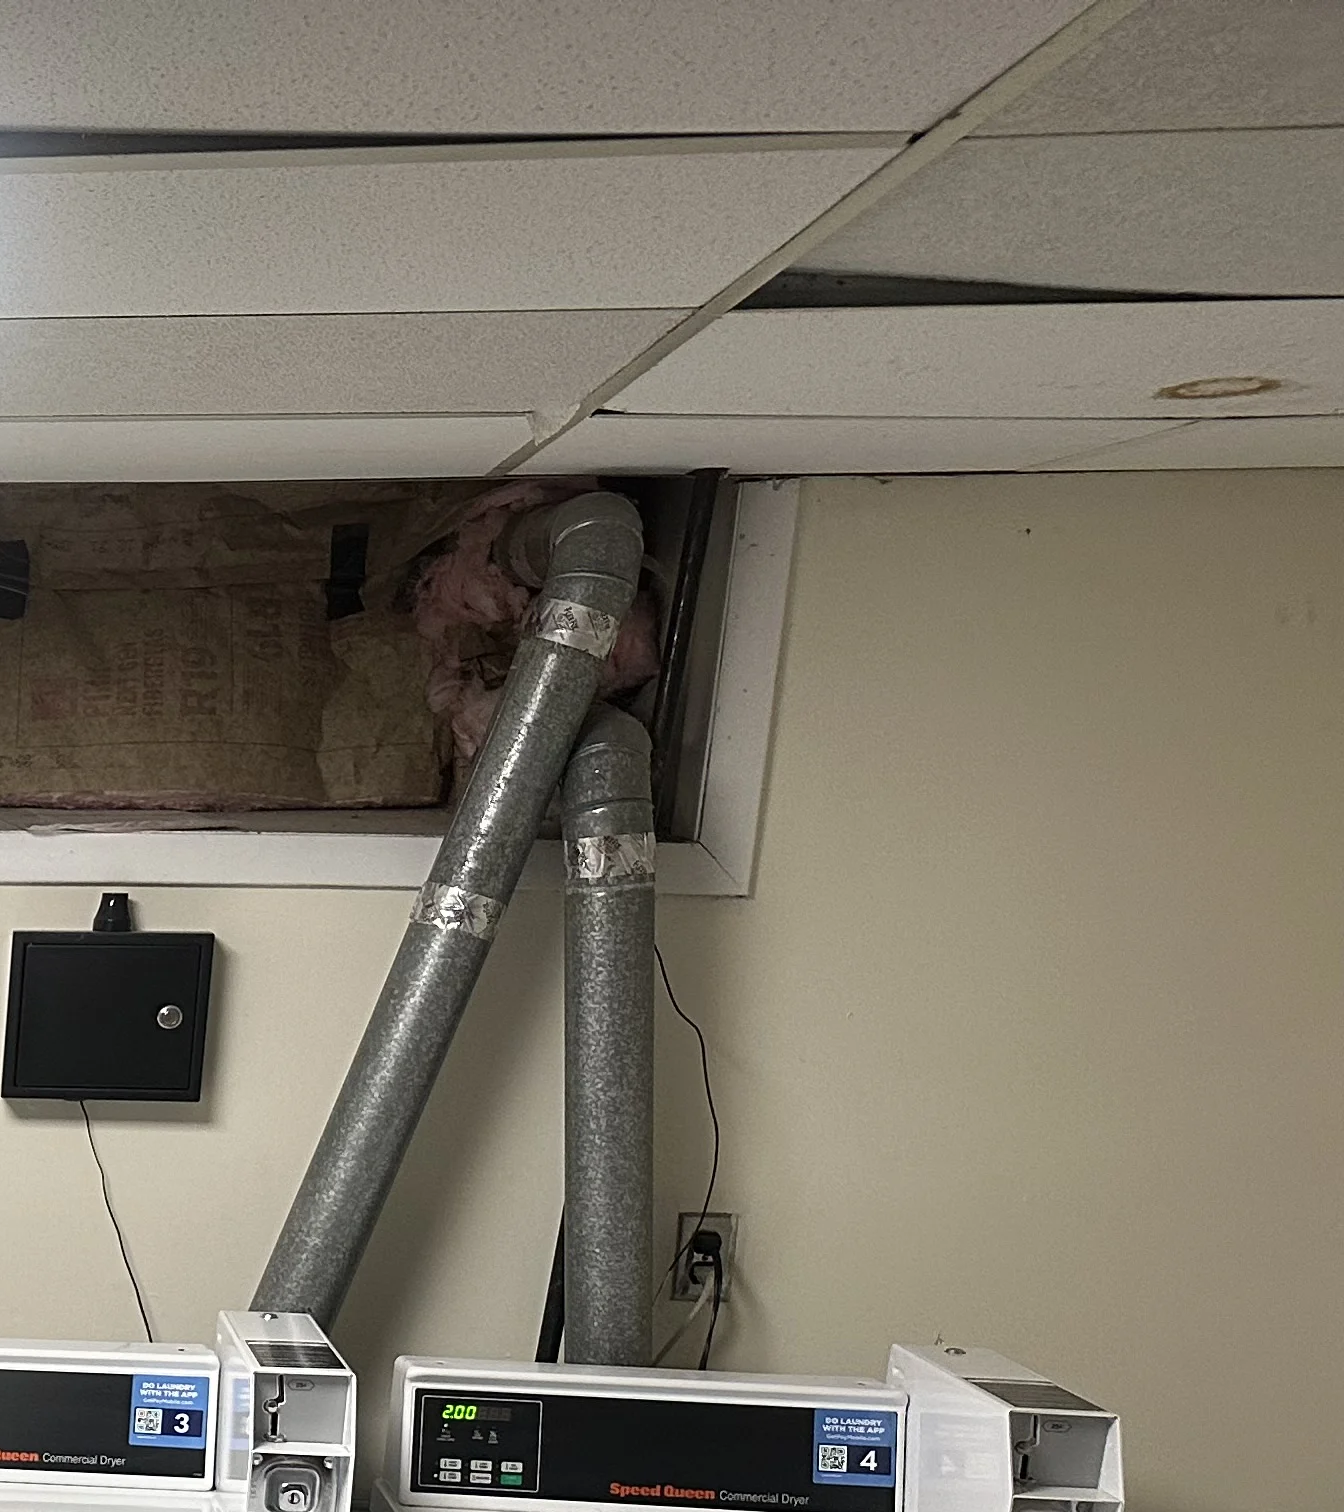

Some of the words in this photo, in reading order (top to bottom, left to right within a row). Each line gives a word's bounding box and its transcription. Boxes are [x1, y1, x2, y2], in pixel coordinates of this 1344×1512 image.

[156, 1383, 196, 1391] LAUNDRY
[173, 1413, 189, 1433] 3
[822, 1424, 846, 1432] WITH
[840, 1418, 882, 1426] LAUNDRY
[43, 1453, 97, 1465] Commercial
[100, 1455, 126, 1467] Dryer
[859, 1450, 878, 1471] 4
[610, 1482, 661, 1497] Speed
[664, 1485, 715, 1499] Queen
[719, 1490, 778, 1503] Commercial
[781, 1493, 809, 1507] Dryer
